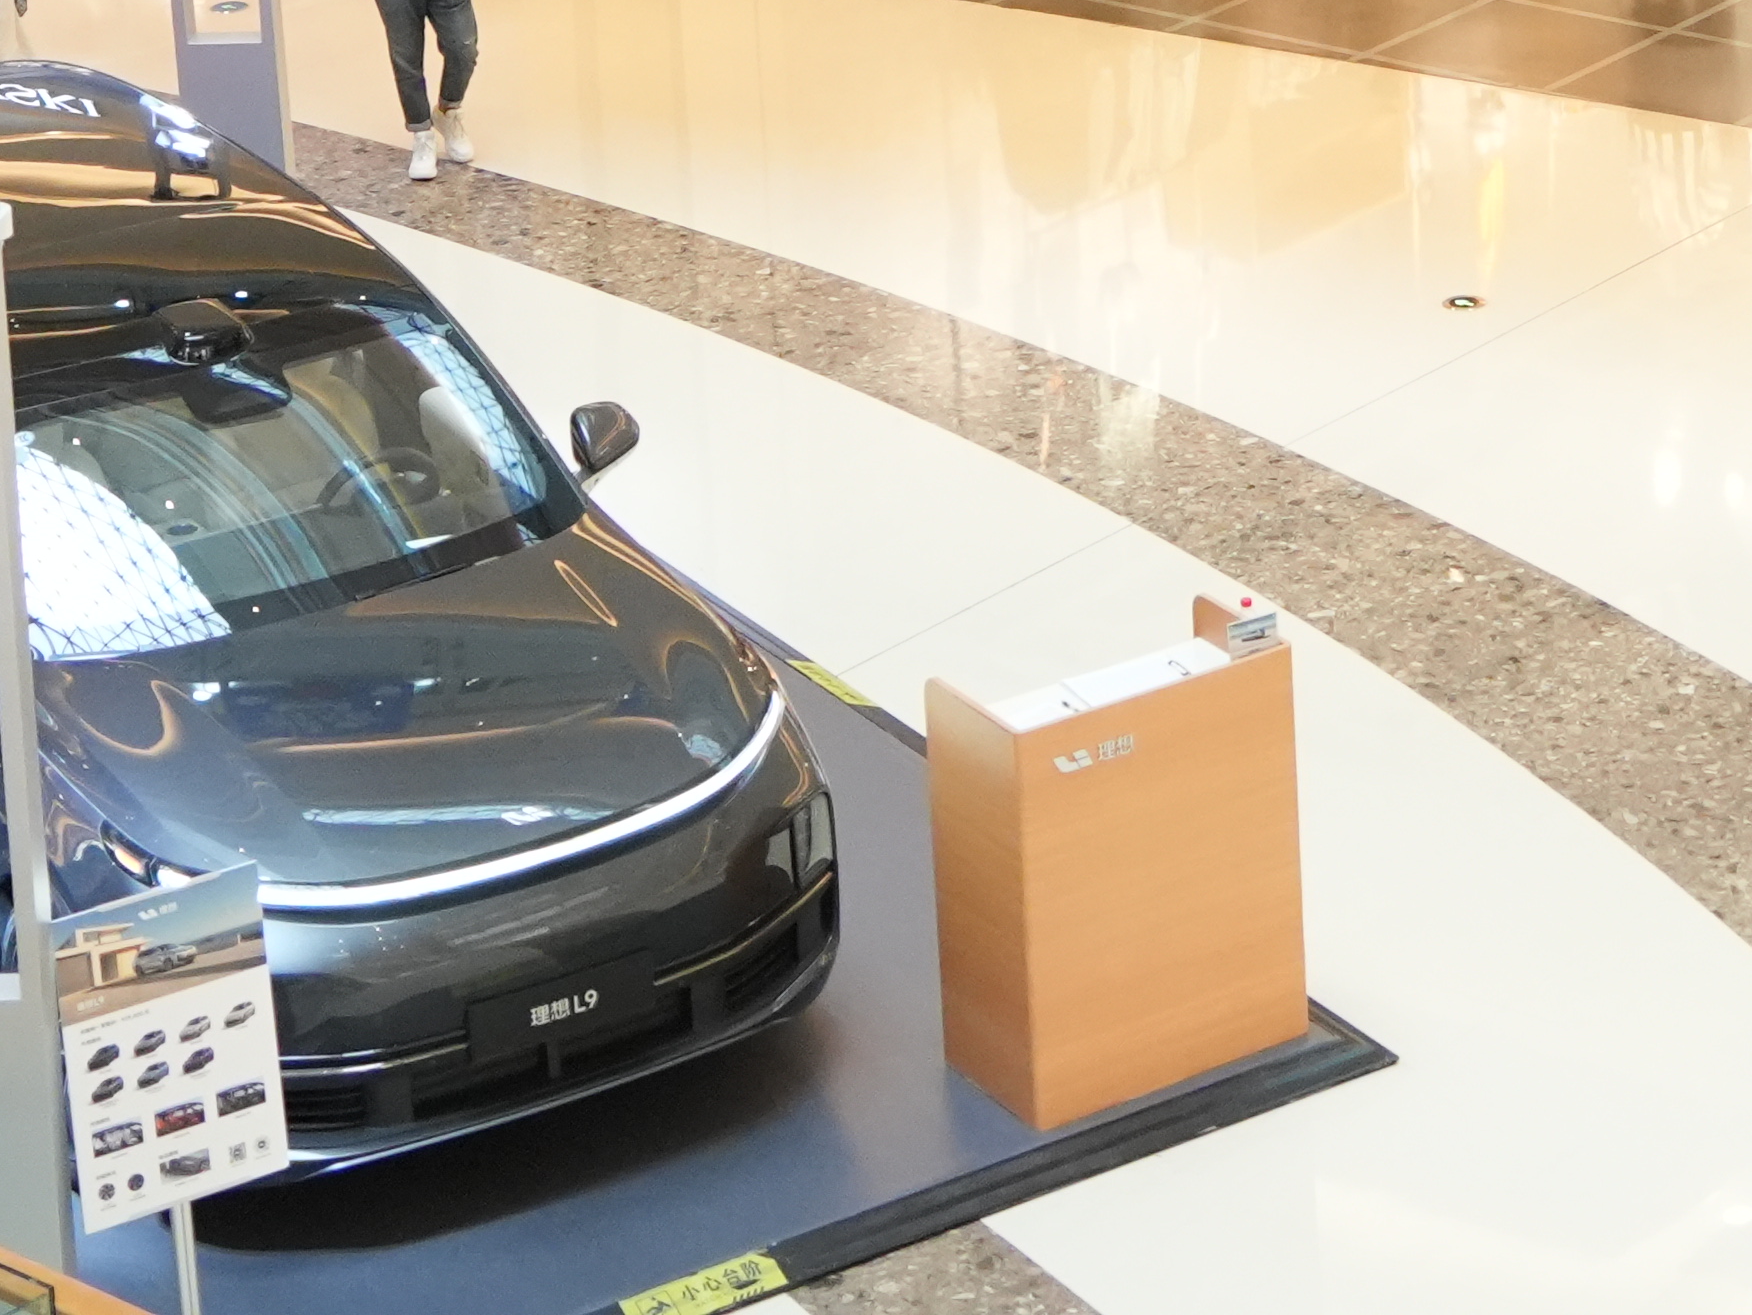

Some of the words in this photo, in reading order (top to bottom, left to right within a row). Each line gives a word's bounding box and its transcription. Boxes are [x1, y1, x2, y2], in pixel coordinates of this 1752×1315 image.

[1097, 734, 1134, 761] 理想
[530, 998, 570, 1026] 理想
[573, 988, 598, 1013] L9
[682, 1260, 762, 1301] 小心台阶
